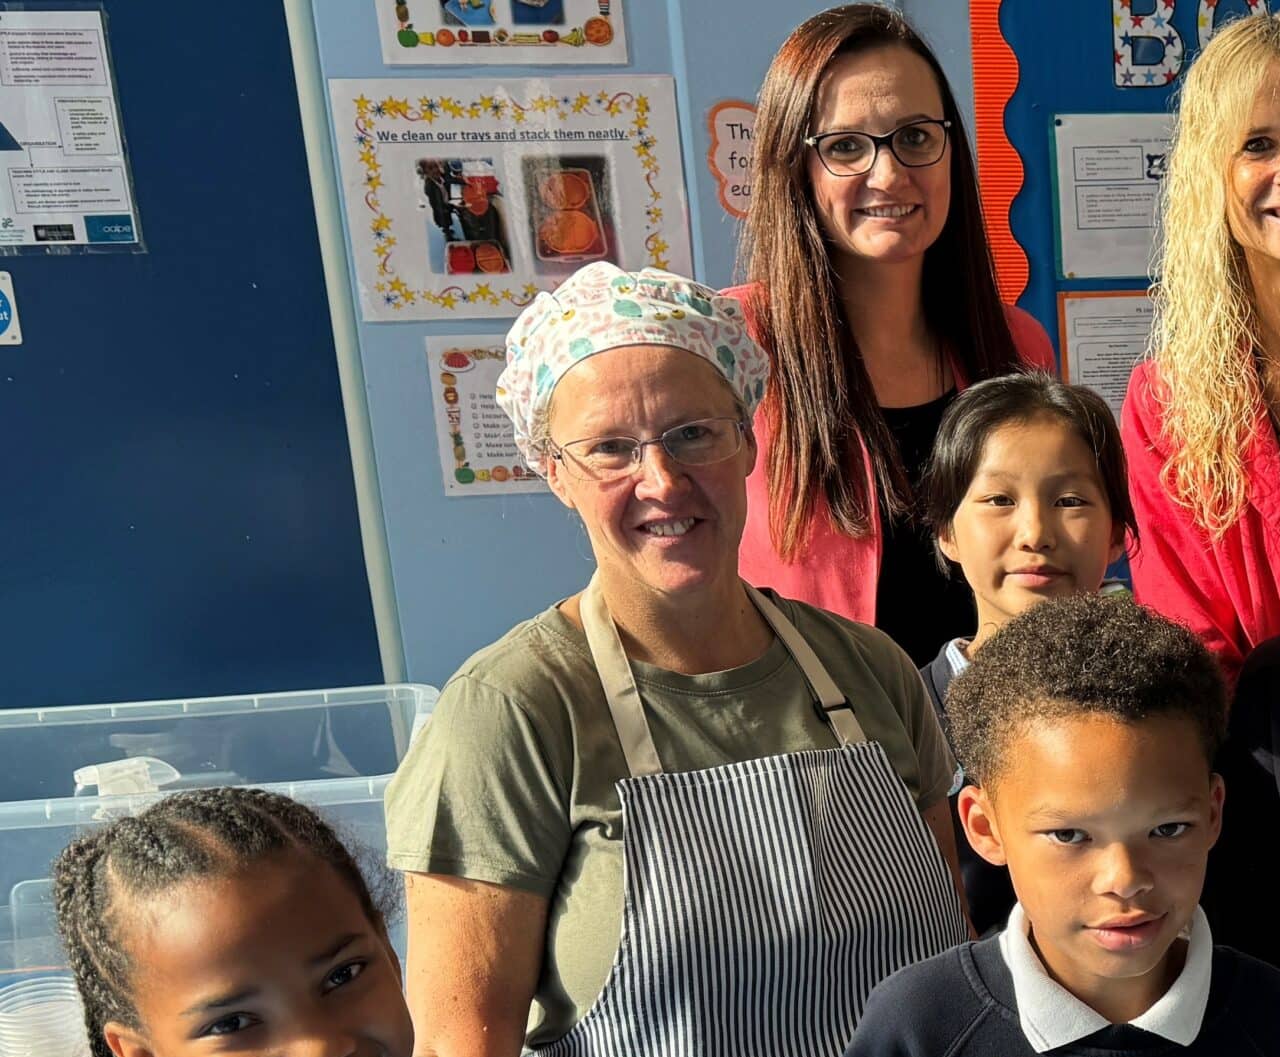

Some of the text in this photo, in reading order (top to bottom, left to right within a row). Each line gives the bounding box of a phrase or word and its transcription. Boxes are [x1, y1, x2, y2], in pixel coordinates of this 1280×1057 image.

[377, 127, 629, 142] We clean our trays and stack them neatly.
[725, 123, 755, 140] Th
[731, 184, 752, 197] ea
